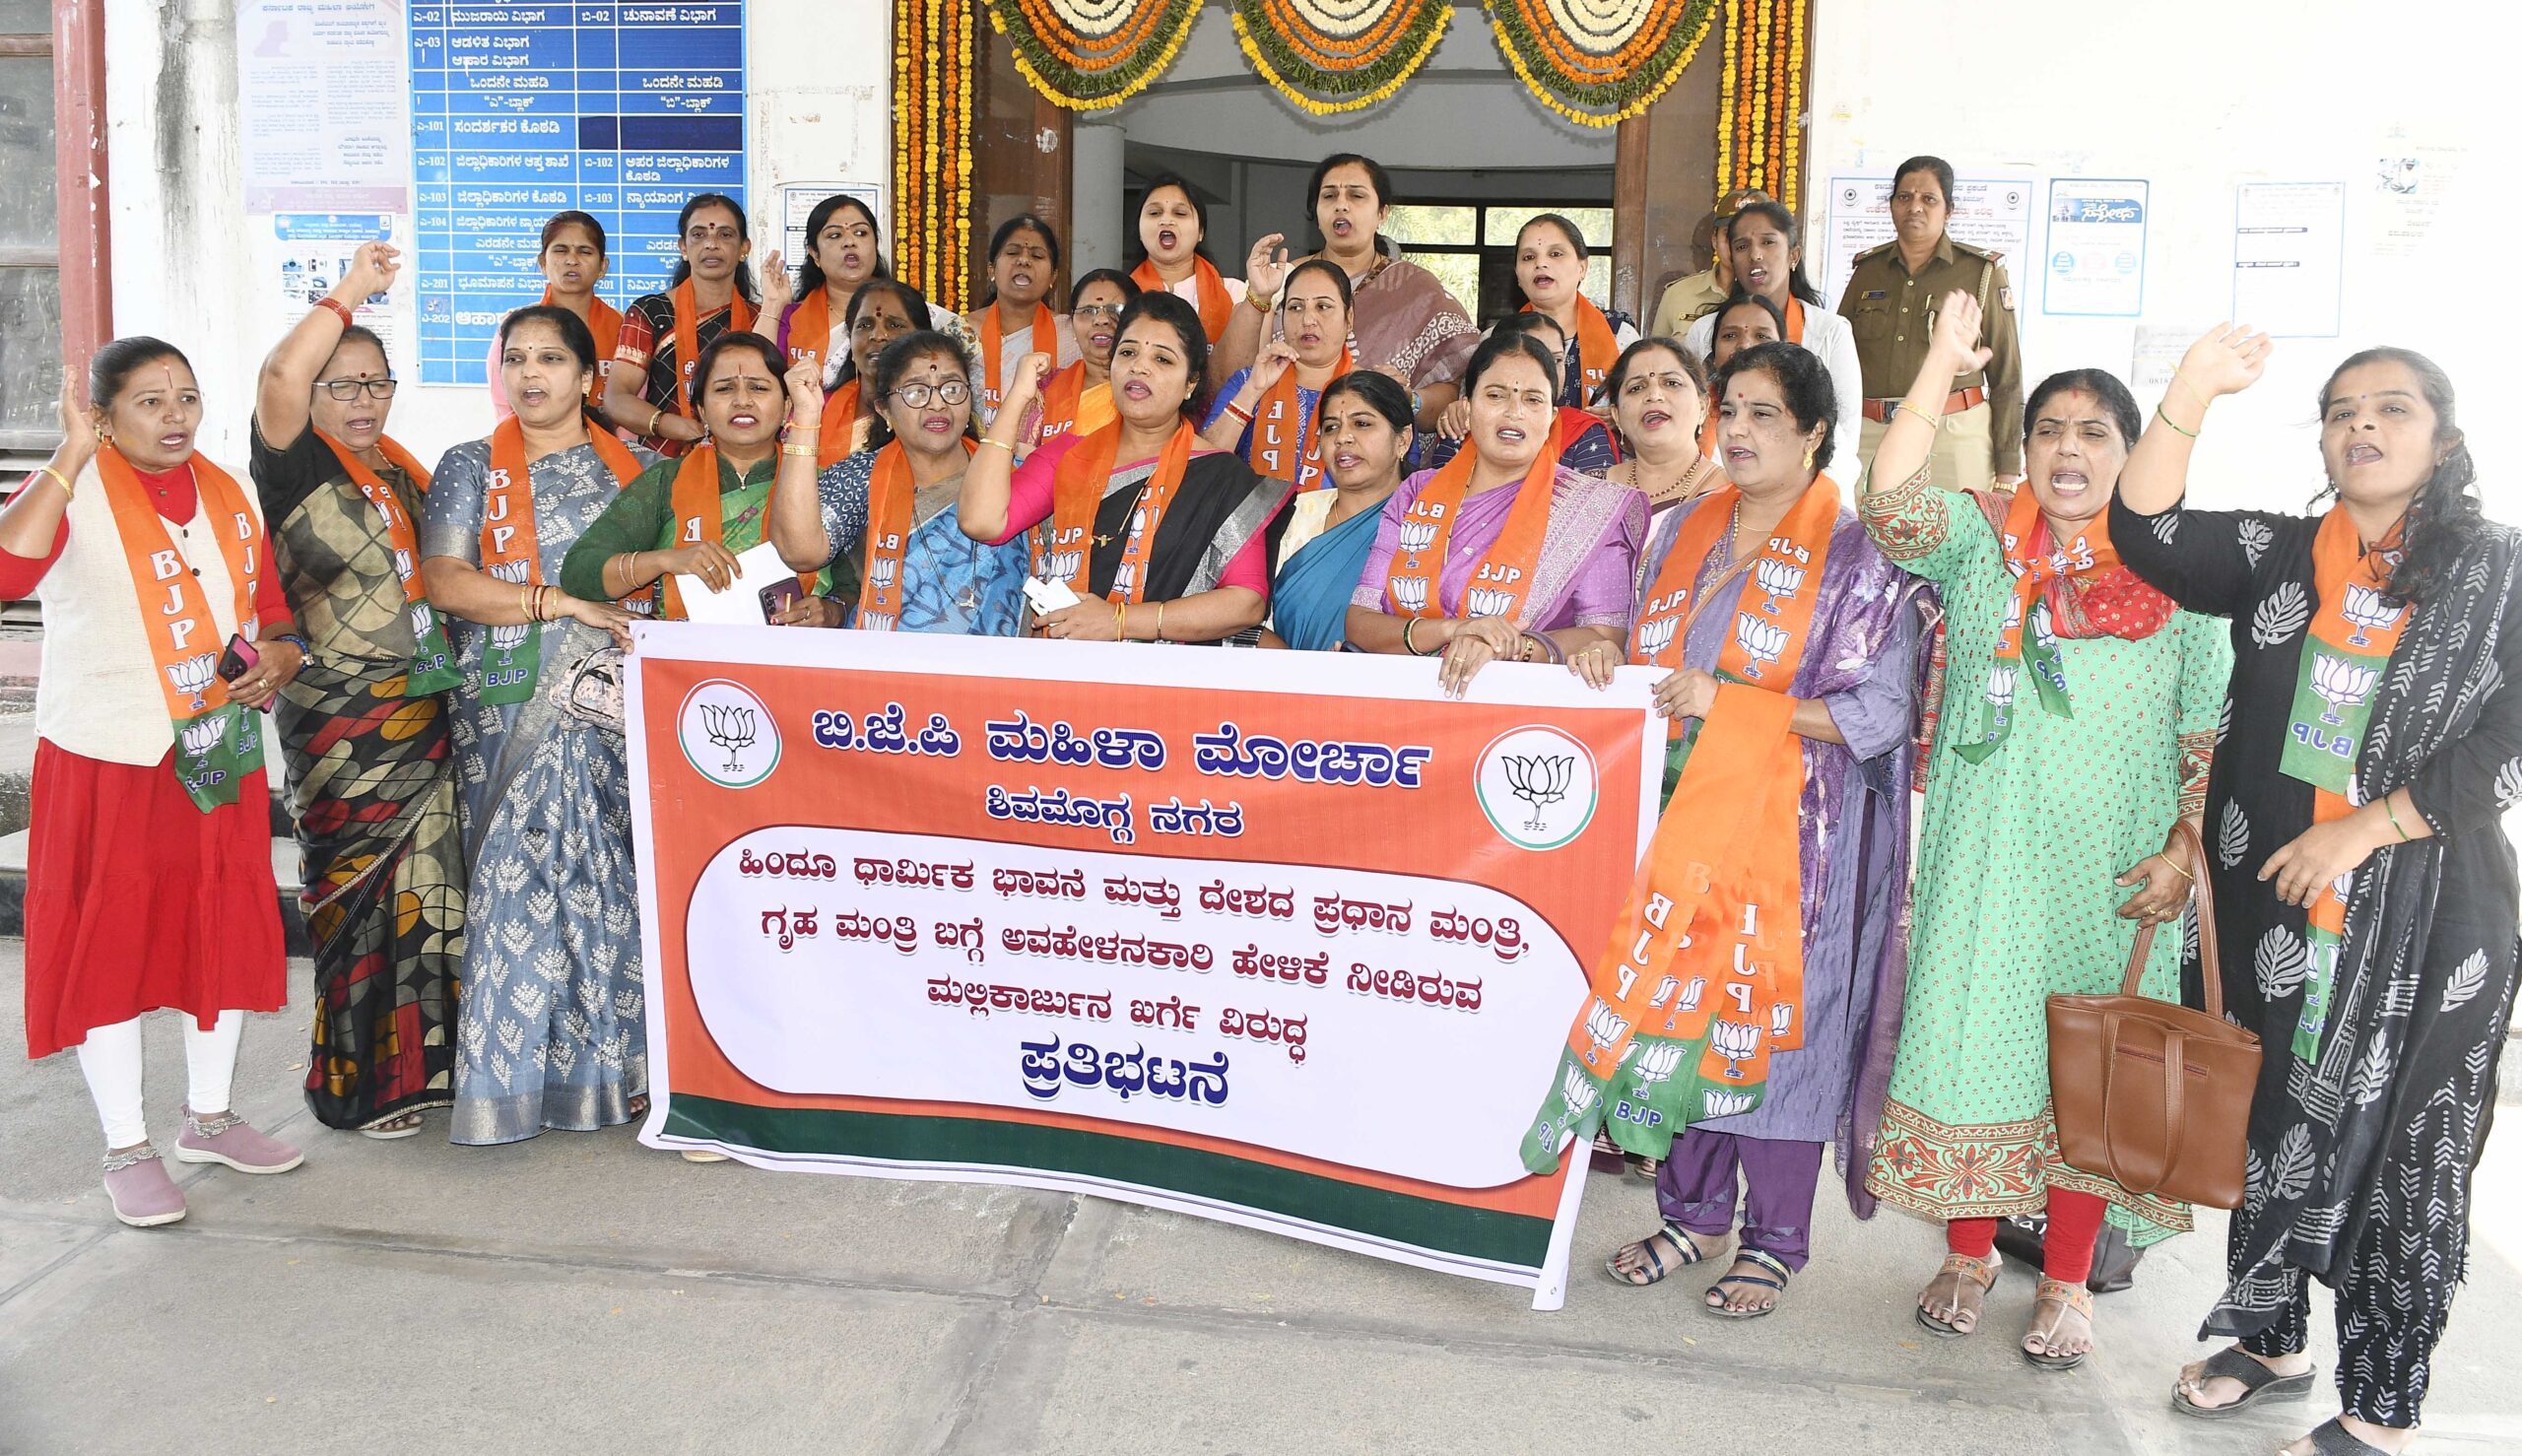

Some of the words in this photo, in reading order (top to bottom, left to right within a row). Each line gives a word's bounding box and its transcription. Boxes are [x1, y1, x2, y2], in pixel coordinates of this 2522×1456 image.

[511, 10, 545, 24] ವಿಭಾಗ
[624, 8, 677, 21] ಚುನಾವಣೆ
[679, 8, 716, 24] ವಿಭಾಗ
[451, 35, 490, 48] ಆಡಳಿತ
[493, 35, 530, 50] ವಿಭಾಗ
[492, 53, 529, 68] ವಿಭಾಗ
[470, 76, 510, 89] ಒಂದನೇ
[513, 76, 549, 89] ಮಹಡಿ
[642, 76, 684, 89] ಒಂದನೇ
[687, 76, 723, 89] ಮಹಡಿ
[475, 237, 515, 249] ಎರಡನೇ
[517, 237, 543, 249] ಮಹ
[1042, 420, 1073, 438] BJP
[1297, 433, 1321, 487] JP
[488, 467, 515, 554] BJP
[233, 511, 258, 610] BJP
[149, 549, 196, 651] BJP
[1647, 588, 1688, 617] BJP
[485, 667, 529, 689] BJP
[813, 703, 960, 758] ಬಿ.ಜೆ.ಪಿ
[986, 713, 1165, 773] ಮಹಿಳಾ
[1194, 723, 1431, 789] ಮೋರ್ಚಾ
[986, 786, 1135, 843] ಶಿವಮೊಗ್ಗ
[1151, 800, 1244, 837] ನಗರ
[739, 848, 836, 878] ಹಿಂದೂ
[853, 856, 974, 891] ಧಾರ್ಮಿಕ
[992, 867, 1086, 899] ಭಾವನೆ
[1103, 875, 1181, 918] ಮತ್ತು
[1199, 879, 1294, 920] ದೇಶದ
[1313, 893, 1413, 935] ಪ್ರಧಾನ
[1429, 905, 1530, 960] ಮಂತ್ರಿ,
[762, 905, 818, 951] ಗೃಹ
[835, 908, 917, 954] ಮಂತ್ರಿ
[934, 916, 984, 962] ಬಗ್ಗೆ
[1002, 924, 1214, 970] ಅವಹೇಳನಕಾರಿ
[1232, 943, 1329, 986] ಹೇಳಿಕೆ
[1347, 962, 1483, 1011] ನೀಡಿರುವ
[927, 975, 1111, 1020] ಮಲ್ಲಿಕಾರ್ಜುನ
[1130, 995, 1201, 1029] ಖರ್ಗೆ
[1219, 1008, 1308, 1065] ವಿರುದ್ಧ
[1021, 1031, 1229, 1103] ಪ್ರತಿಭಟನೆ
[1614, 1099, 1664, 1128] BJP
